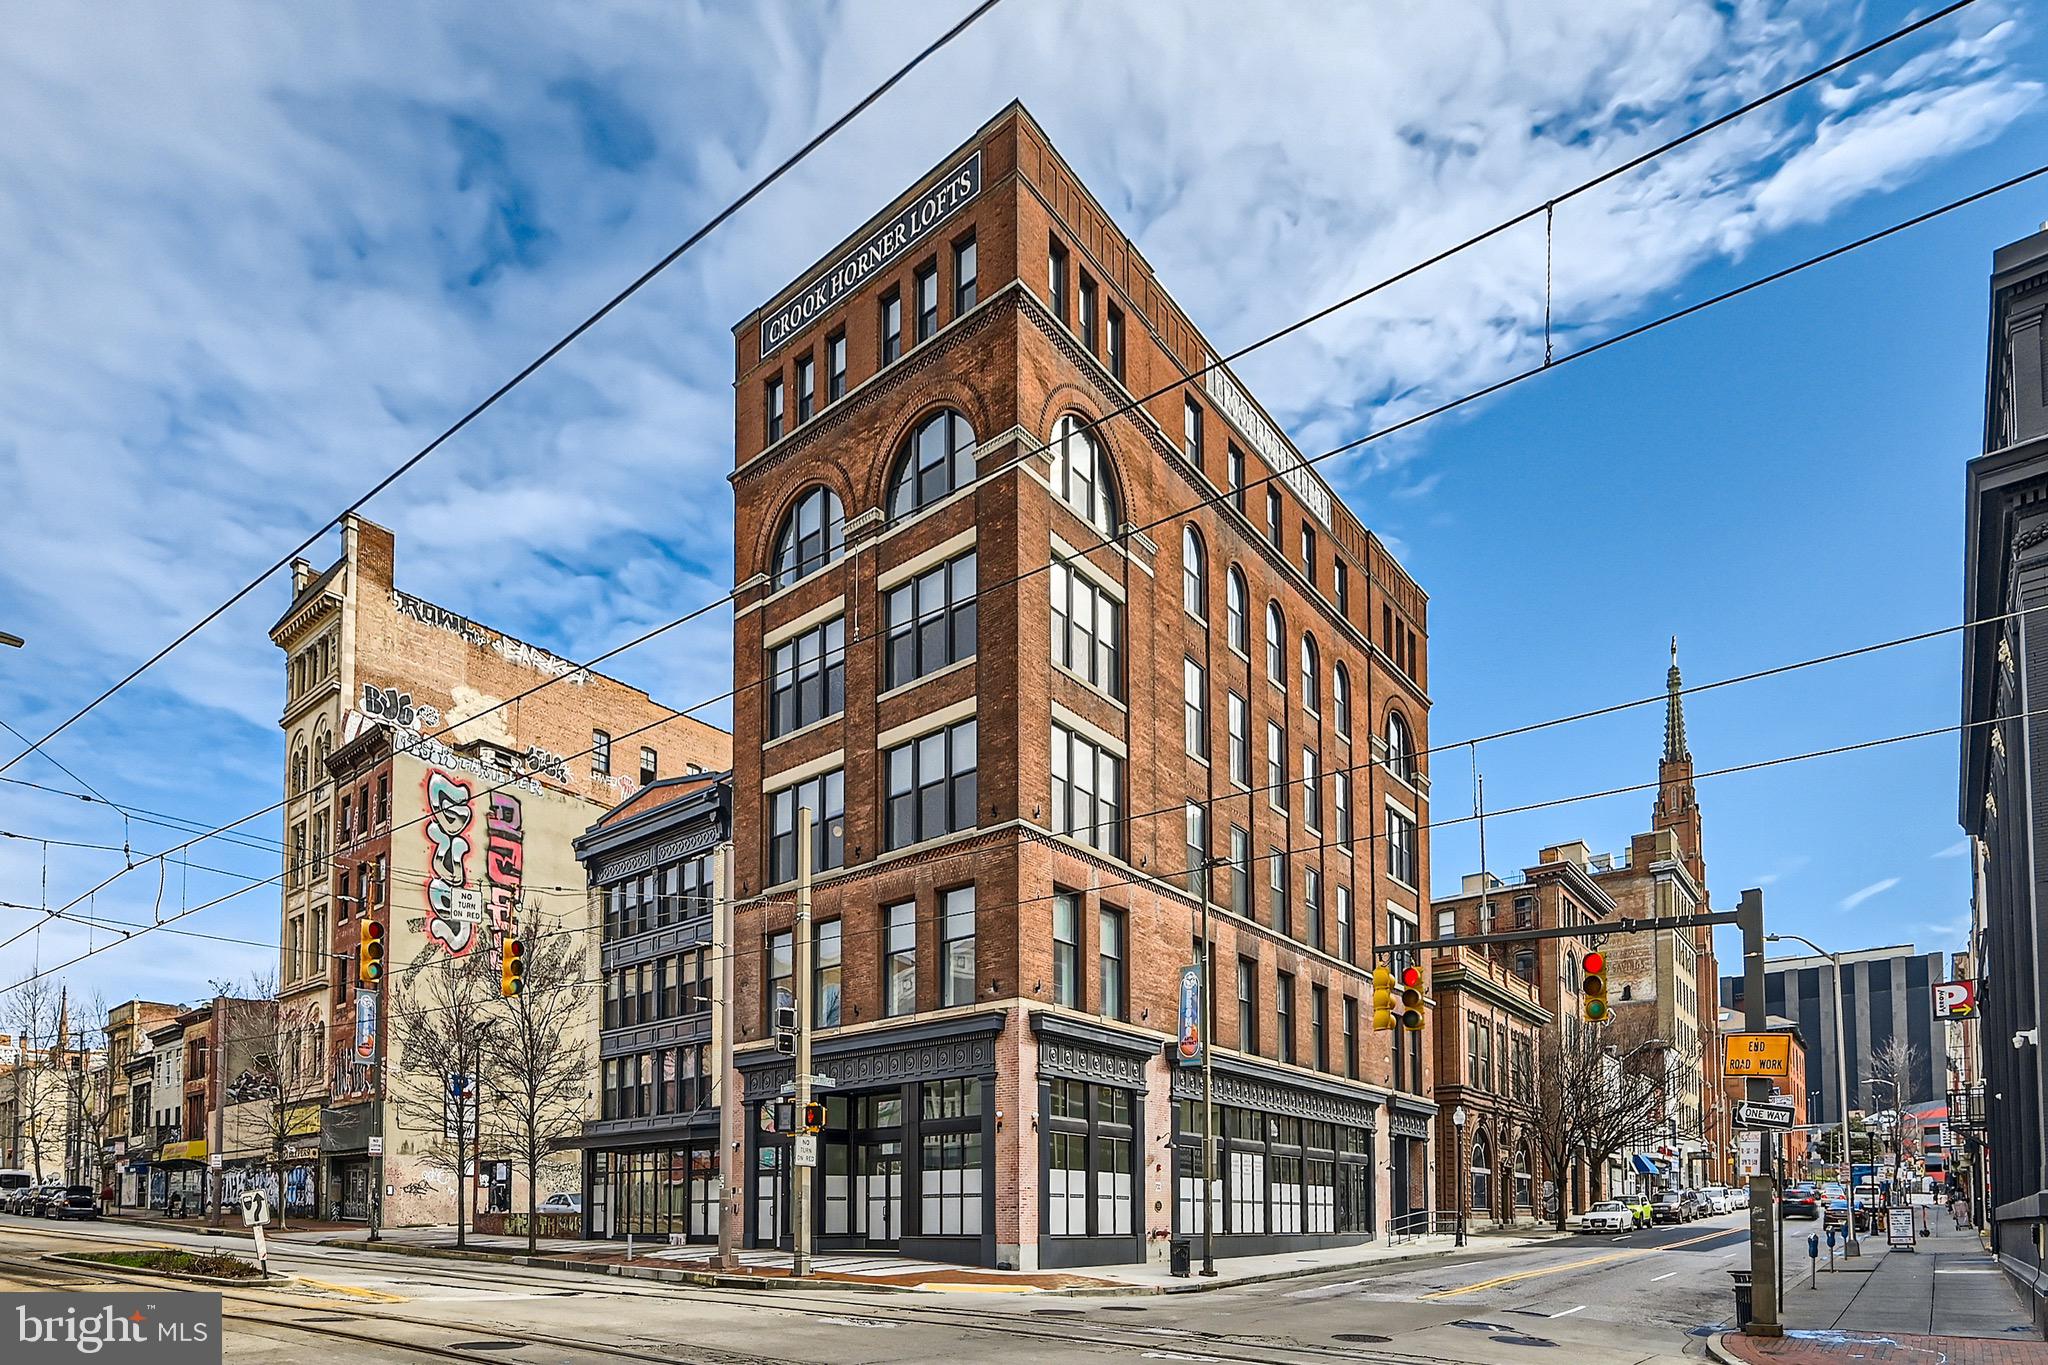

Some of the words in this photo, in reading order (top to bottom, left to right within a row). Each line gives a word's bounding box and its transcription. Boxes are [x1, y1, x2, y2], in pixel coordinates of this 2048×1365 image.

[769, 283, 827, 344] CROOK
[830, 224, 907, 299] HORNER
[910, 170, 972, 238] LOFTS
[459, 902, 476, 910] TURN
[1748, 1041, 1765, 1052] END
[1729, 1059, 1751, 1070] ROAD
[1759, 1059, 1783, 1070] WORK
[1745, 1108, 1764, 1119] ONE
[1766, 1110, 1787, 1121] WAY
